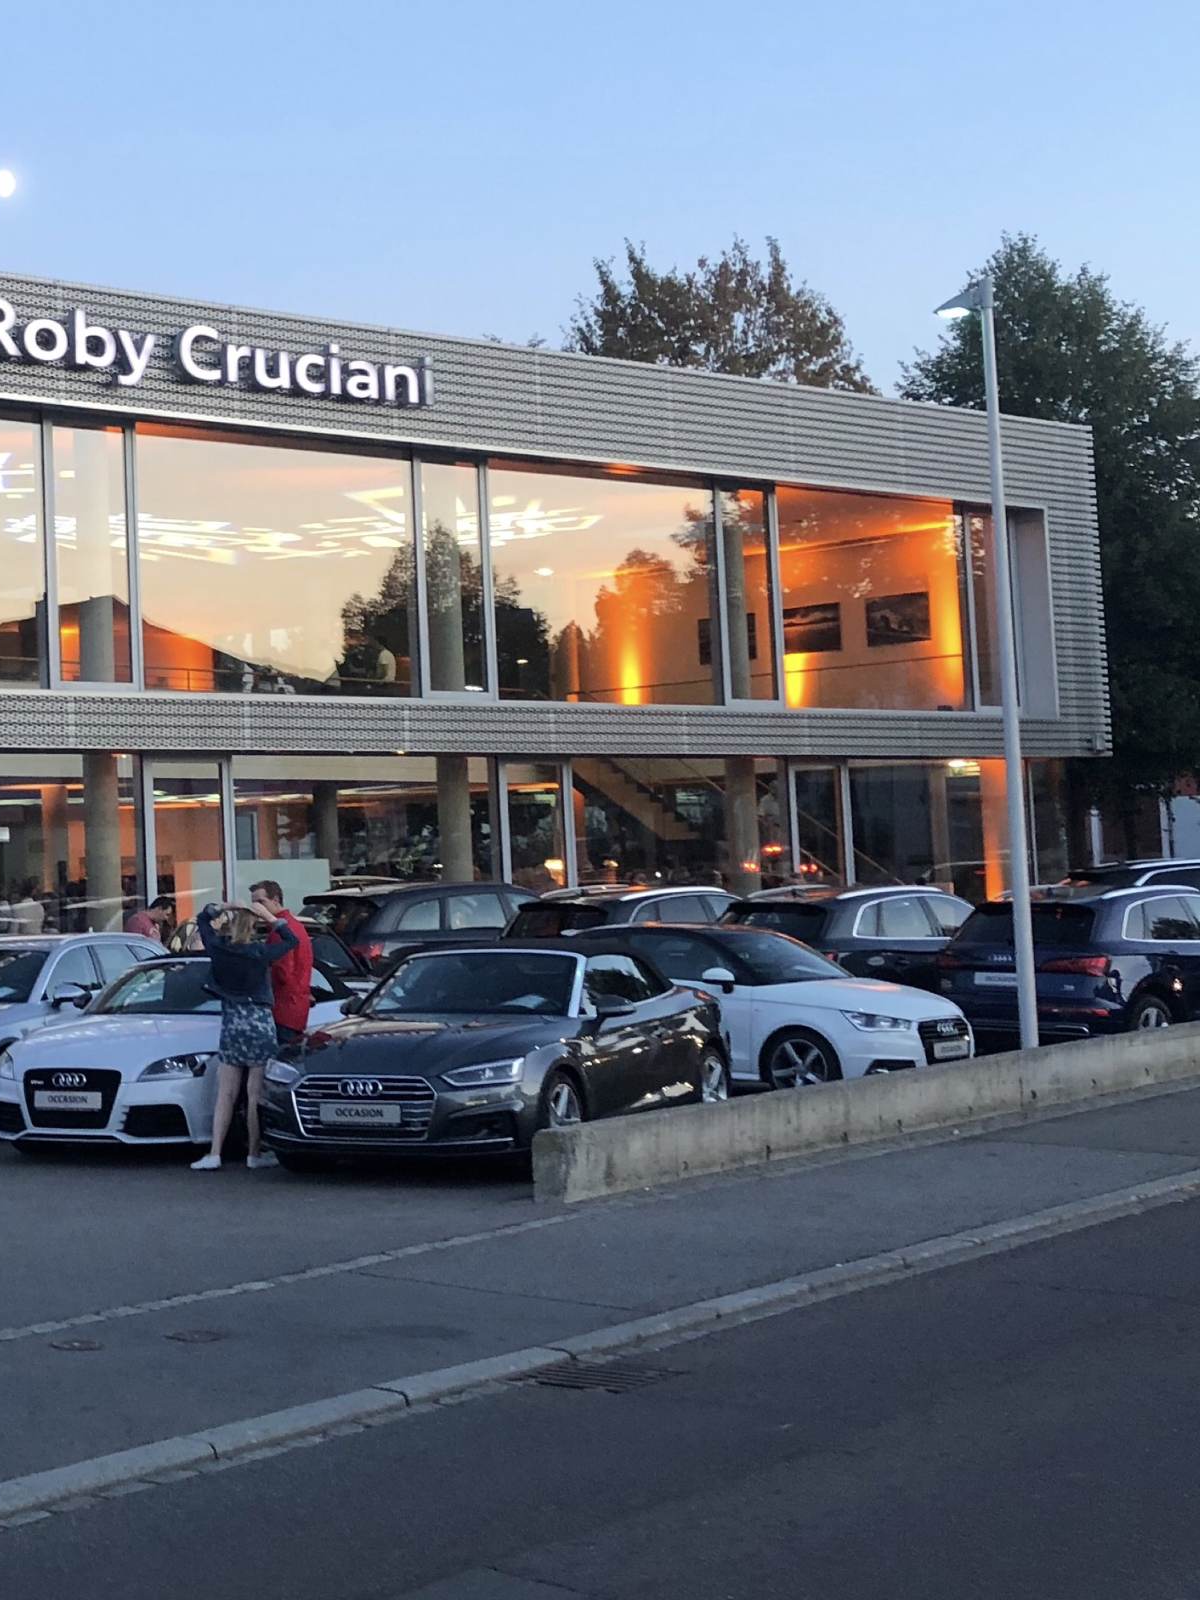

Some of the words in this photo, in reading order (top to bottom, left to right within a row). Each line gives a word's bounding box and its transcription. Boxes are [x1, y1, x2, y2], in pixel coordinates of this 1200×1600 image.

[178, 324, 435, 405] Cruciani
[47, 1095, 89, 1104] OCCASION
[334, 1107, 384, 1118] OCCASION
